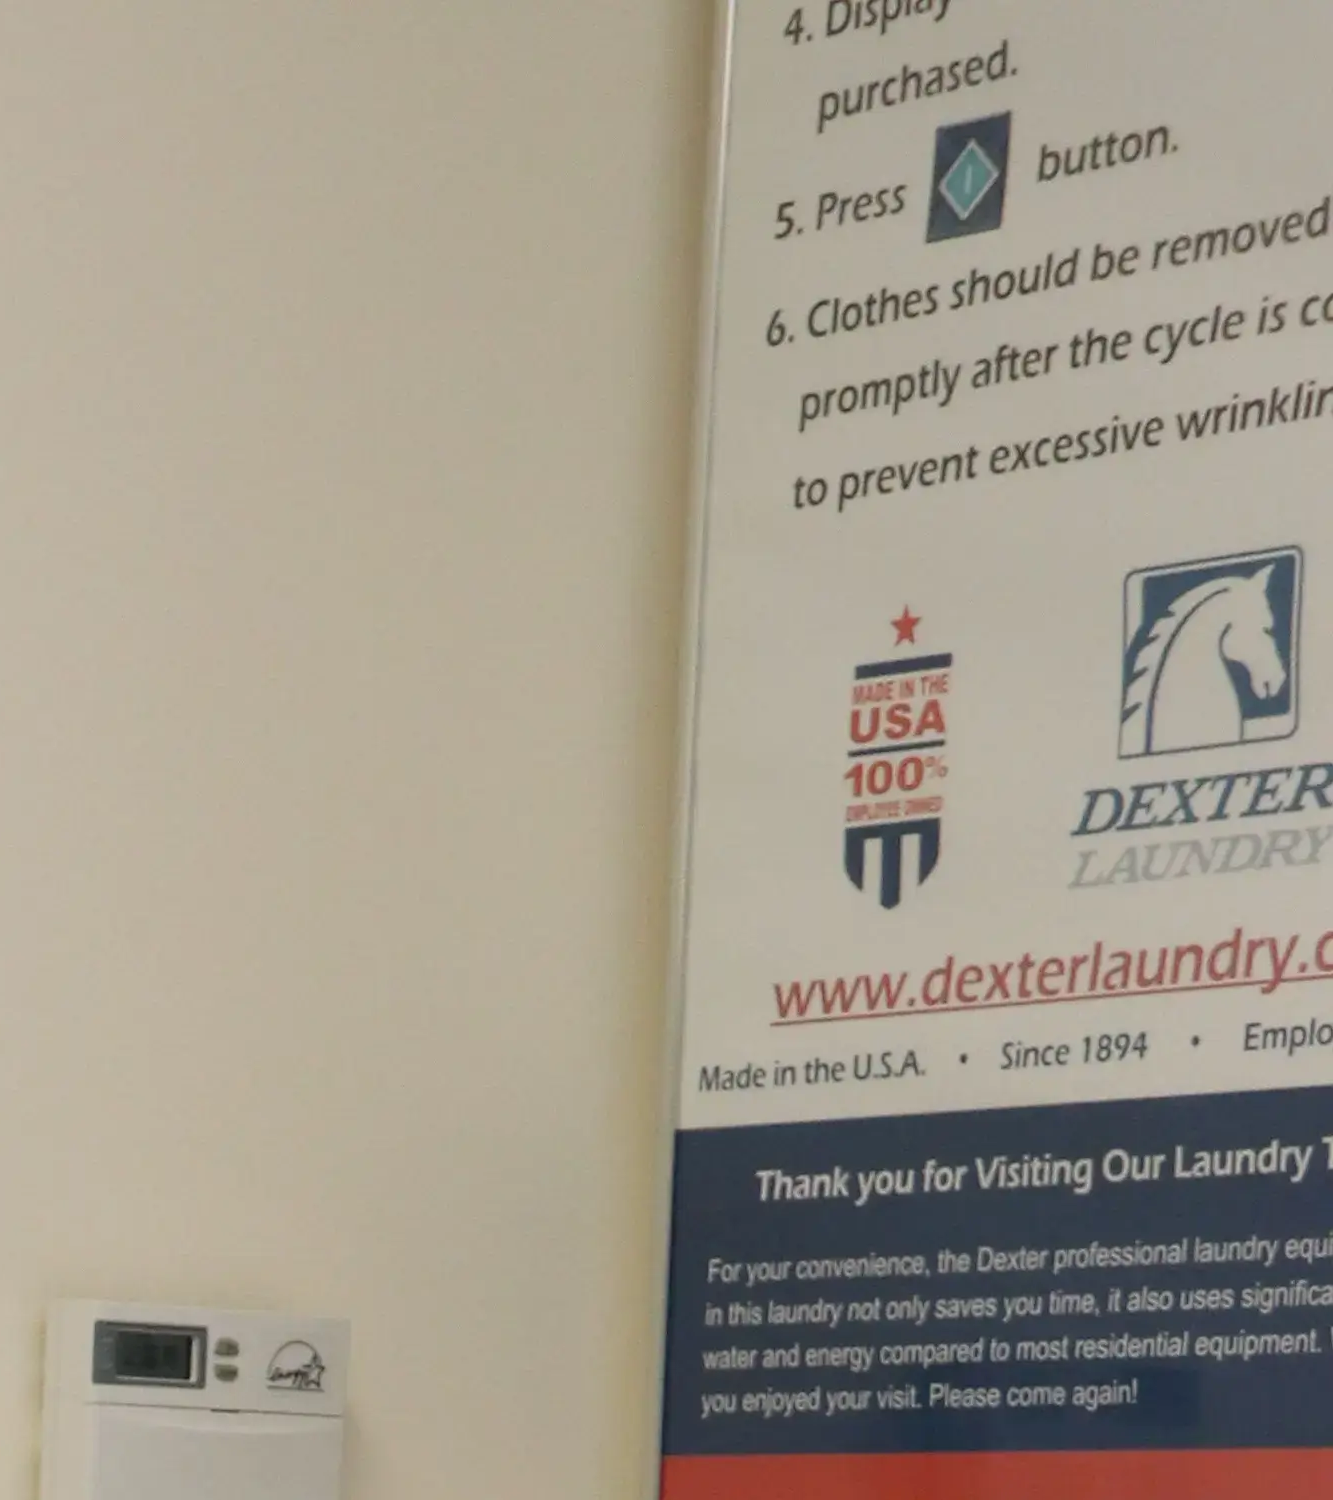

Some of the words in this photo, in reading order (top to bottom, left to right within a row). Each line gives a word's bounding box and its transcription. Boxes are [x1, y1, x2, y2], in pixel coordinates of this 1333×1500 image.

[783, 8, 813, 46] 4.
[817, 39, 1018, 134] purchased.
[774, 200, 804, 240] 5.
[816, 183, 907, 231] Press
[1037, 124, 1178, 183] button.
[766, 305, 796, 348] 6.
[808, 281, 939, 341] Clothes
[950, 248, 1077, 311] should
[1090, 243, 1140, 281] be
[1151, 196, 1332, 271] removed
[798, 358, 962, 432] promptly
[970, 341, 1059, 390] after
[1069, 325, 1132, 369] the
[1143, 304, 1245, 365] cycle
[1256, 296, 1288, 336] is
[793, 473, 828, 510] to
[838, 444, 979, 514] prevent
[988, 415, 1165, 477] excessive
[850, 699, 946, 744] USA
[843, 756, 949, 797] 100%
[1070, 761, 1333, 837] DEXTER
[1067, 824, 1333, 890] LAUNDRY
[698, 1062, 766, 1093] Made
[773, 1058, 797, 1087] in
[805, 1055, 847, 1085] the
[852, 1051, 927, 1082] U.S.A.
[1000, 1041, 1070, 1072] Since
[1082, 1031, 1149, 1065] 1894
[755, 1167, 850, 1203] Thank
[856, 1166, 915, 1206] you
[922, 1158, 967, 1193] for
[974, 1152, 1093, 1195] Visiting
[1102, 1148, 1166, 1183] Our
[1174, 1139, 1314, 1184] Laundry
[706, 1257, 741, 1284] For
[745, 1259, 791, 1288] your
[794, 1251, 932, 1280] convenience,
[937, 1247, 972, 1274] the
[976, 1244, 1049, 1273] Dexter
[1052, 1237, 1189, 1275] professional
[1193, 1234, 1280, 1269] laundry
[704, 1301, 724, 1327] in
[728, 1299, 763, 1327] this
[767, 1296, 842, 1329] laundry
[846, 1296, 881, 1322] not
[885, 1295, 931, 1326] only
[934, 1295, 998, 1322] saves
[1003, 1294, 1043, 1324] you
[1048, 1289, 1102, 1318] time,
[1108, 1286, 1122, 1314] it
[1126, 1285, 1174, 1312] also
[1179, 1286, 1235, 1311] uses
[701, 1345, 757, 1370] water
[761, 1341, 800, 1369] and
[804, 1346, 875, 1375] energy
[879, 1336, 985, 1371] compared
[989, 1337, 1010, 1363] to
[1015, 1336, 1070, 1361] most
[1074, 1330, 1190, 1360] residential
[1194, 1328, 1323, 1361] equipment.
[699, 1391, 737, 1419] you
[741, 1385, 822, 1419] enjoyed
[825, 1389, 872, 1416] your
[876, 1383, 923, 1411] visit.
[928, 1380, 1001, 1409] Please
[1006, 1385, 1066, 1408] come
[1071, 1377, 1139, 1412] again!
